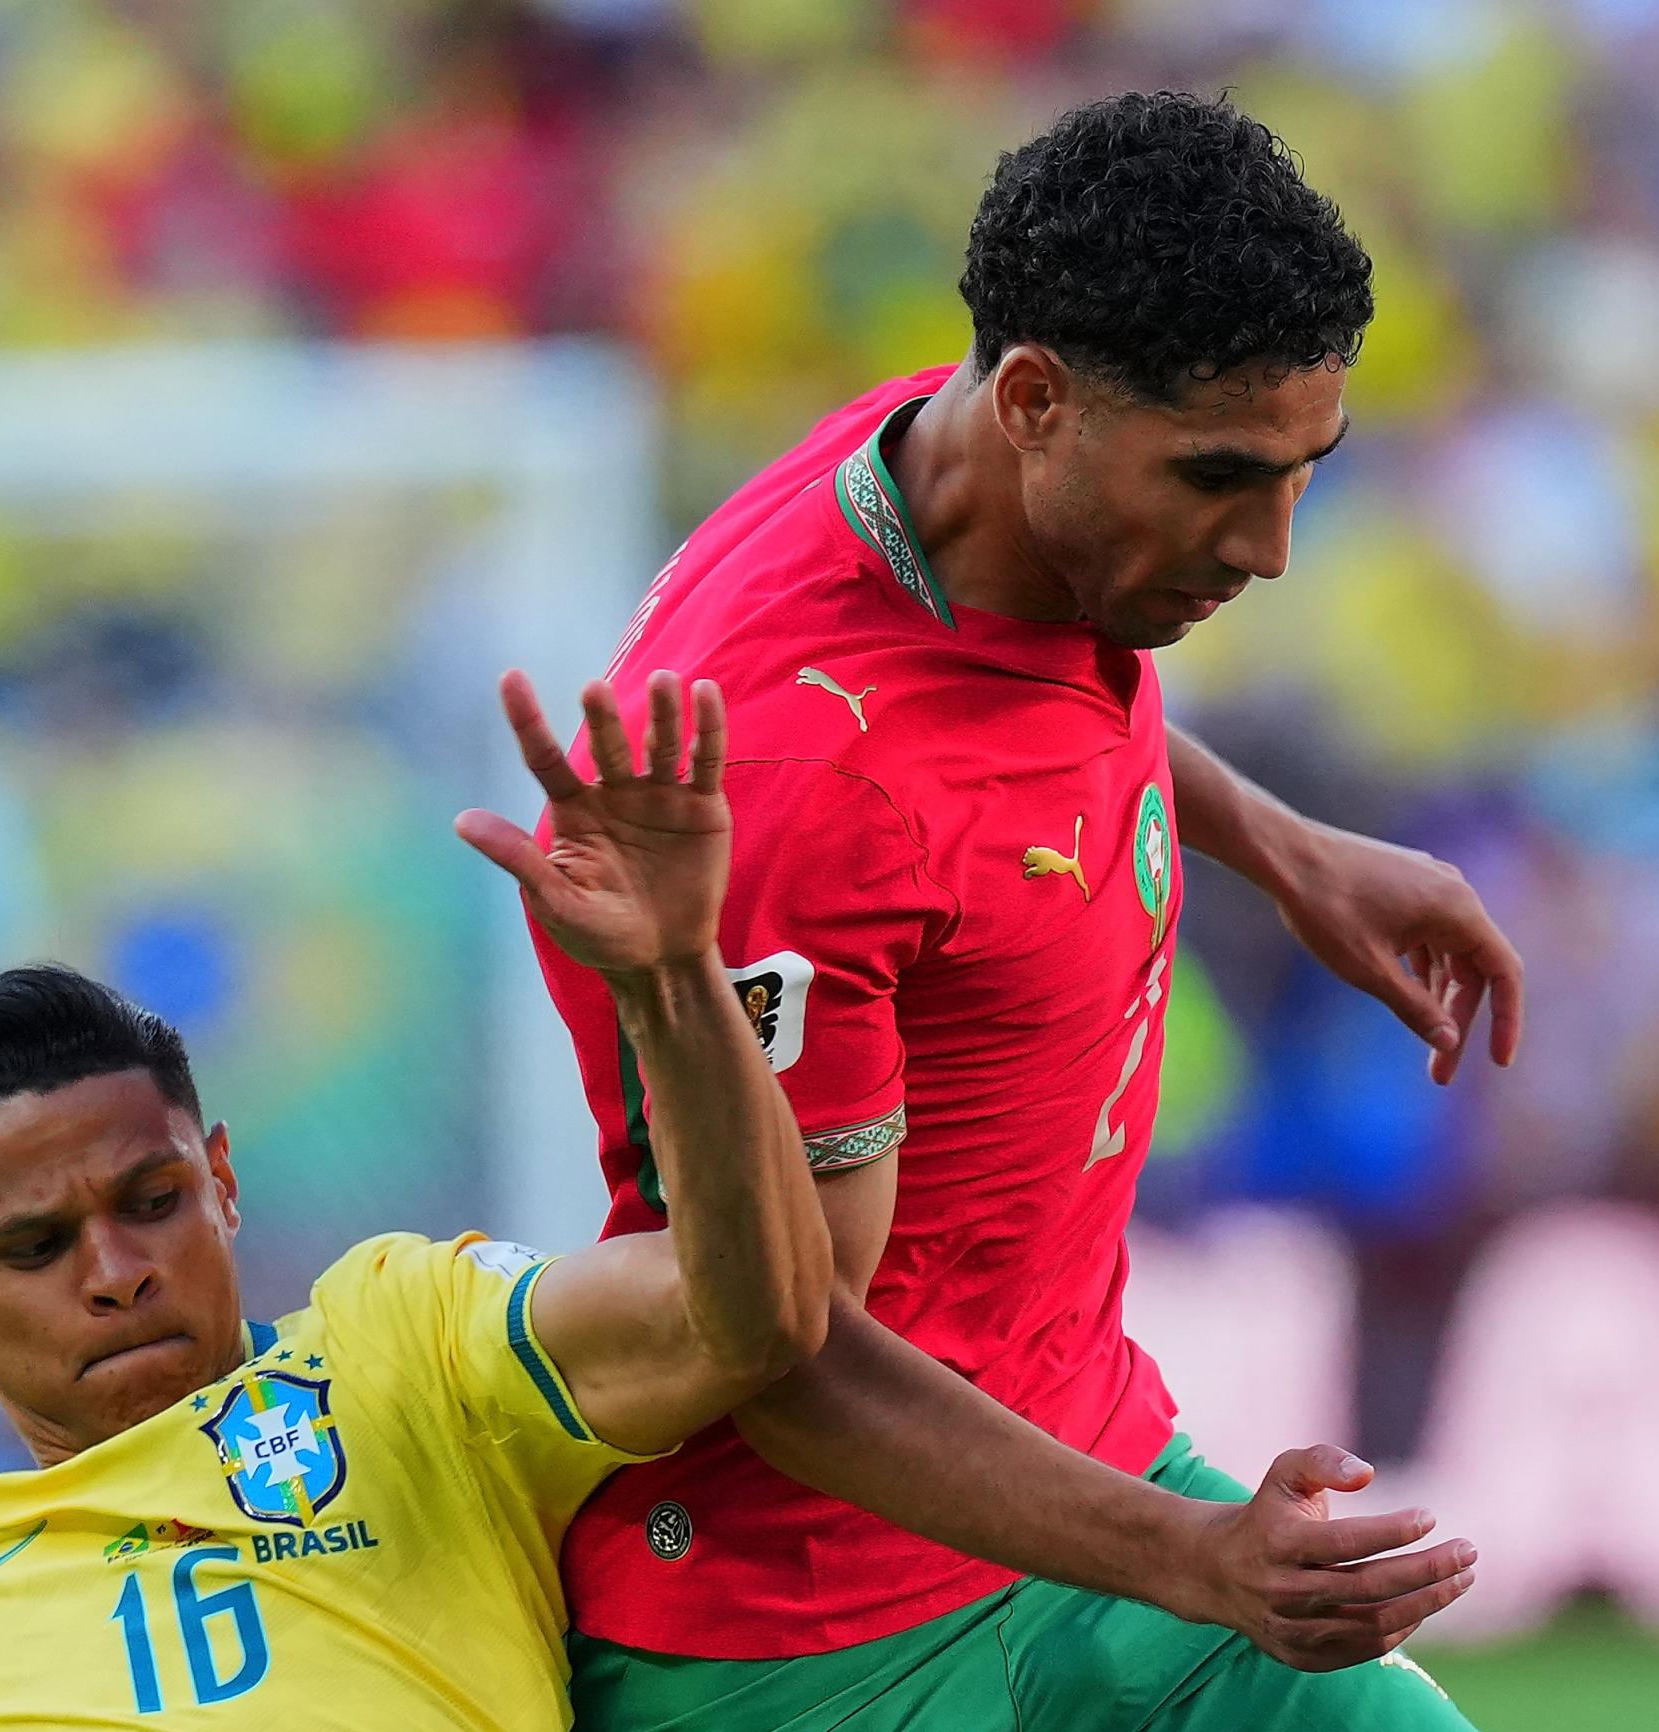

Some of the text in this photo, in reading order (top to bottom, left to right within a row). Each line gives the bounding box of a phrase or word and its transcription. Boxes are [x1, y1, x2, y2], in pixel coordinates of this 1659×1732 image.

[254, 1429, 300, 1460] CBF
[252, 1520, 379, 1564] BRASIL
[110, 1546, 271, 1715] 16
